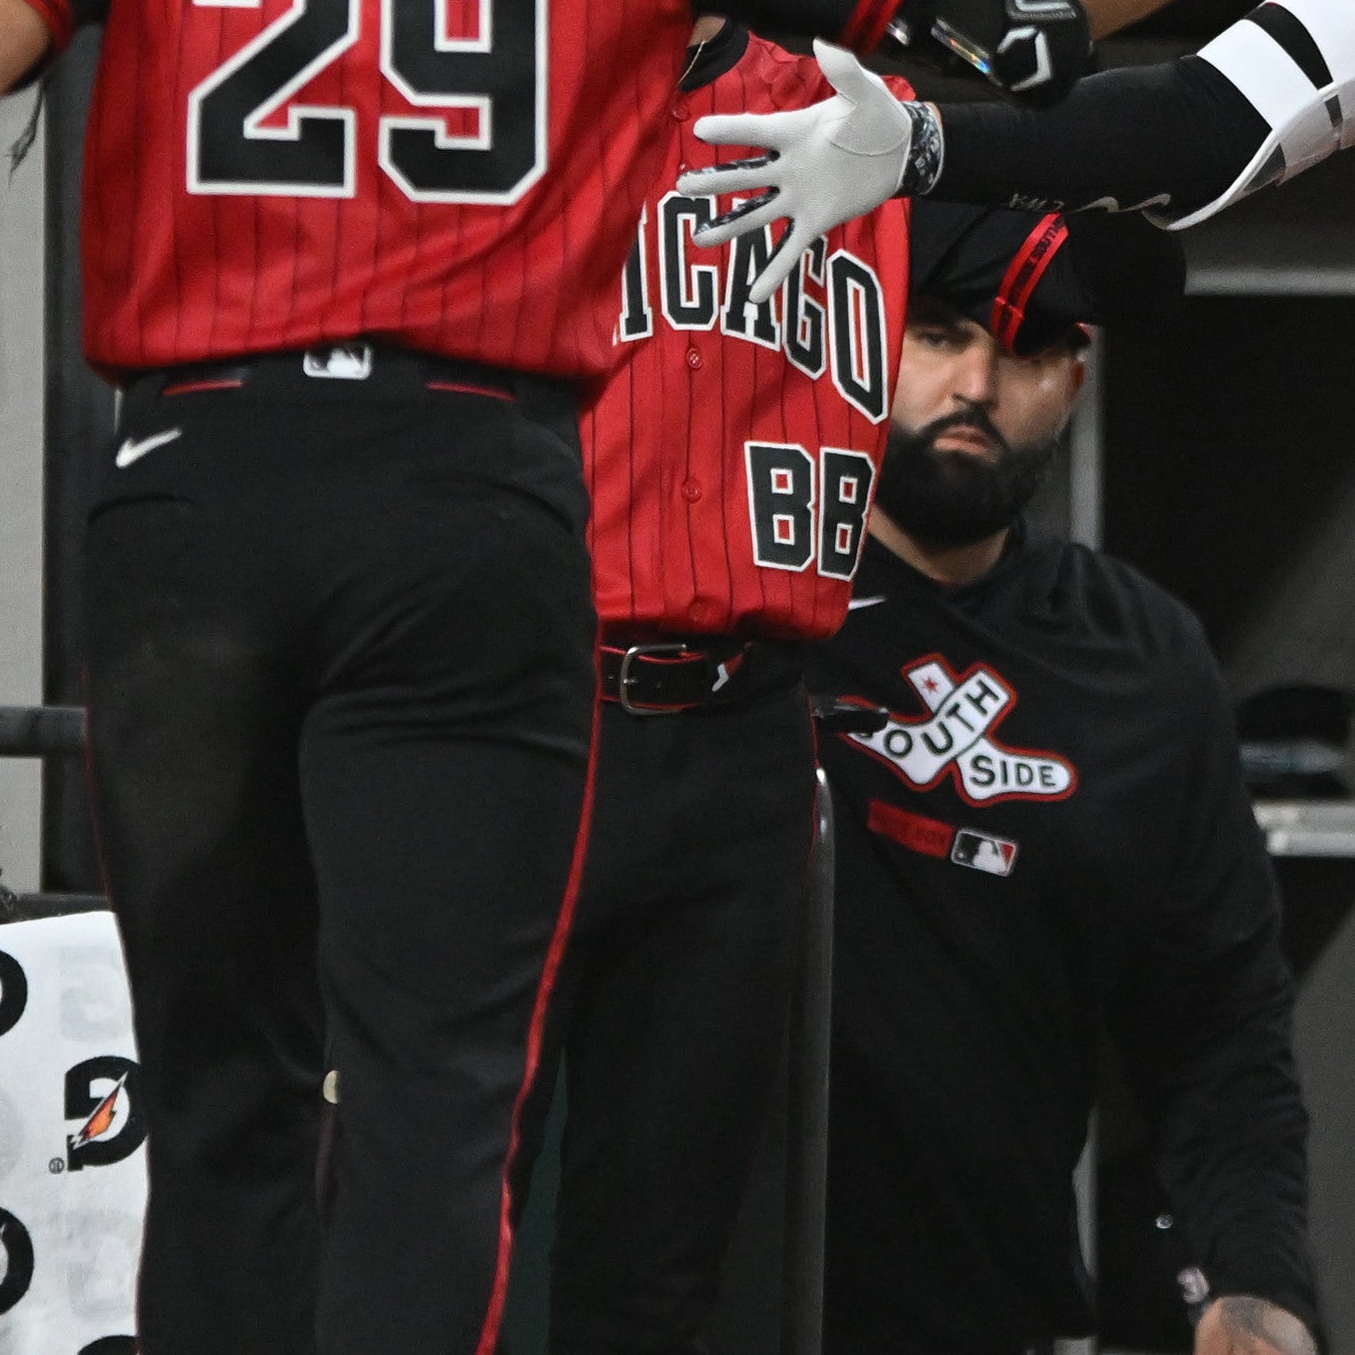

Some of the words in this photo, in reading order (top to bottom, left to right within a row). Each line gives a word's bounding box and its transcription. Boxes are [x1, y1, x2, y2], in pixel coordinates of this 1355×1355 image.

[613, 190, 889, 425] ICAGO
[857, 678, 1001, 757] OUTH
[970, 754, 1057, 787] SIDE
